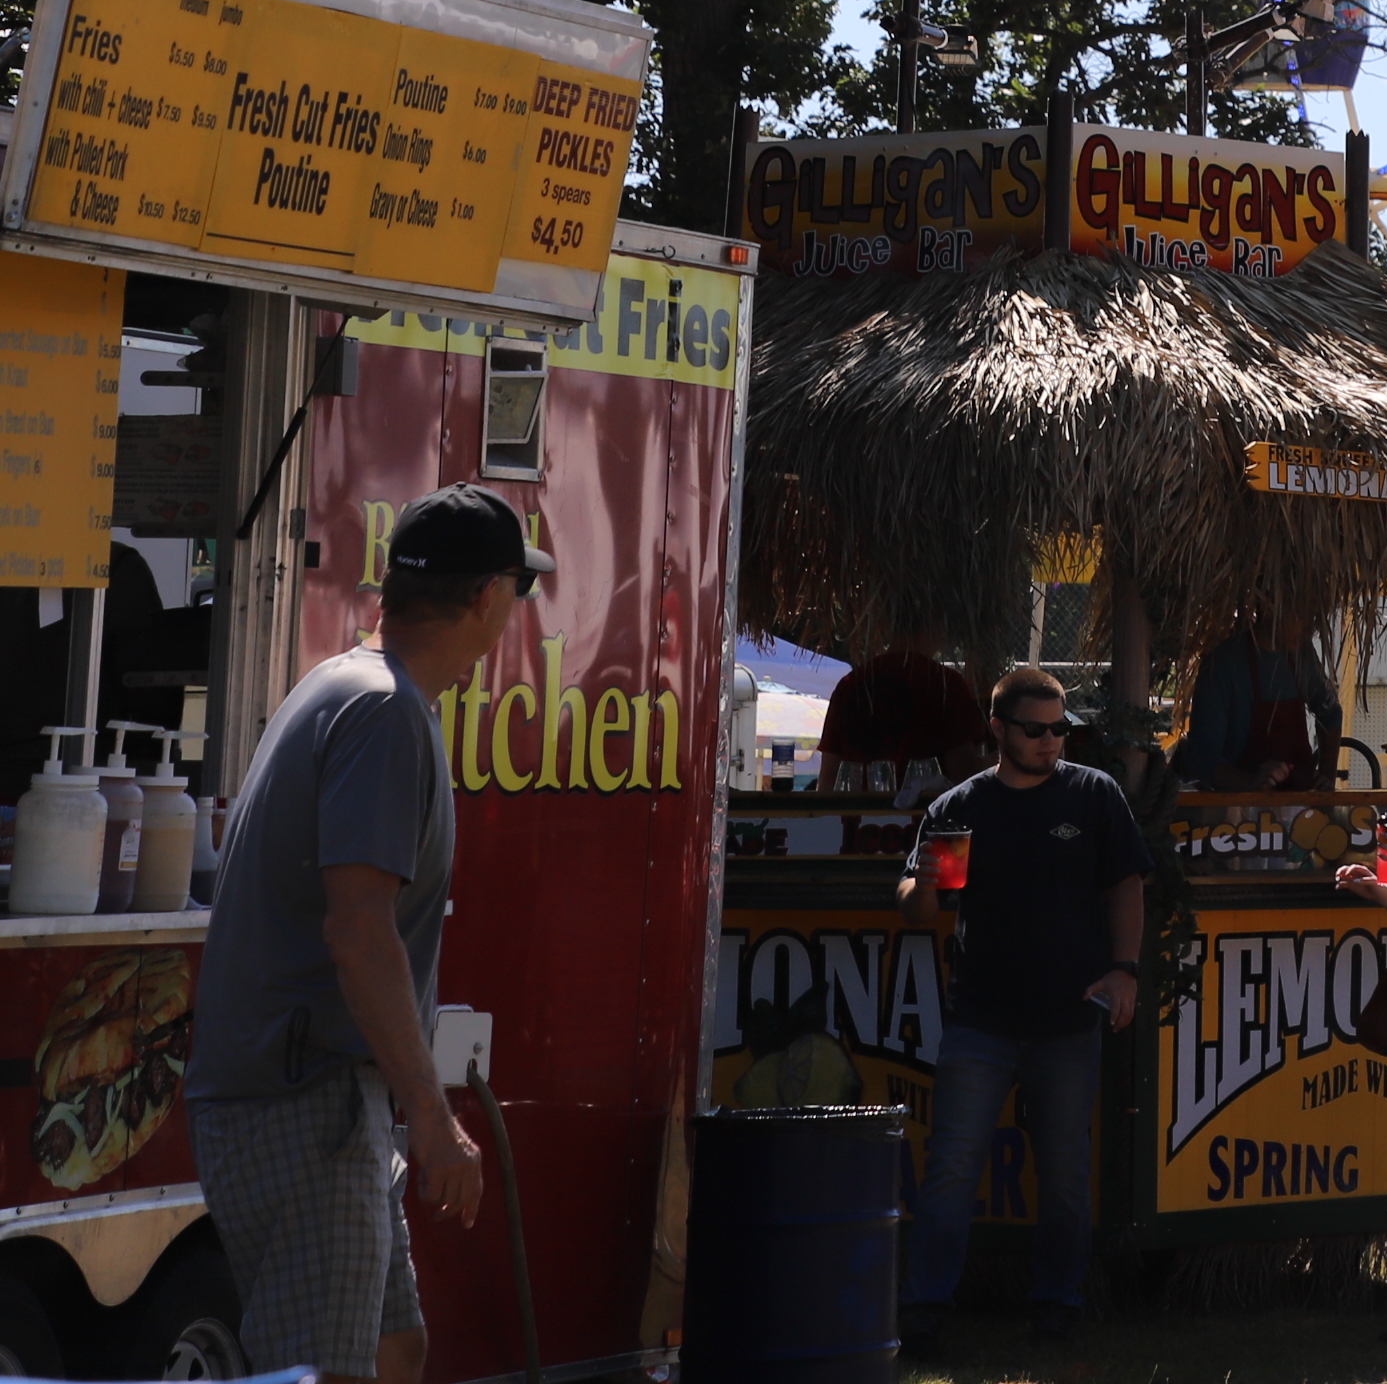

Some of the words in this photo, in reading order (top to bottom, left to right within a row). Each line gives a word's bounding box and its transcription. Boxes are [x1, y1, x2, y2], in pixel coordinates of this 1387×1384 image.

[218, 0, 243, 26] jumbo
[67, 14, 123, 65] Fries
[169, 41, 194, 67] $5.50
[203, 50, 227, 76] $8.00
[57, 72, 83, 112] with
[81, 76, 108, 118] chili
[117, 86, 153, 130] cheese
[156, 96, 182, 123] $7.50
[227, 72, 289, 139] Fresh
[291, 83, 330, 146] Cut
[327, 91, 381, 155] Fries
[393, 68, 449, 114] Poutine
[474, 87, 498, 110] $7.00
[503, 93, 527, 116] $9.00
[532, 75, 582, 120] DEEP
[583, 87, 639, 133] FRIED
[44, 127, 71, 168] with
[69, 132, 106, 177] Pulled
[103, 139, 129, 181] Pork
[382, 123, 409, 162] Onion
[407, 128, 434, 174] Rings
[463, 140, 487, 164] $6.00
[535, 127, 615, 177] PICKLES
[70, 179, 82, 218] &
[81, 180, 119, 226] Cheese
[137, 192, 165, 219] $10.50
[171, 200, 201, 226] $12.50
[253, 147, 331, 216] Poutine
[369, 183, 398, 229] Gravy
[396, 199, 409, 223] or
[407, 189, 439, 229] Cheese
[451, 198, 475, 220] $1.00
[541, 178, 550, 198] 3
[551, 182, 591, 206] spears
[531, 216, 584, 255] $4.50
[617, 278, 731, 372] Fries
[1268, 445, 1313, 464] FRESH
[441, 630, 681, 794] itchen
[1169, 812, 1284, 857] Fresh
[1301, 1059, 1358, 1110] MADE
[1207, 1135, 1359, 1202] SPRING
